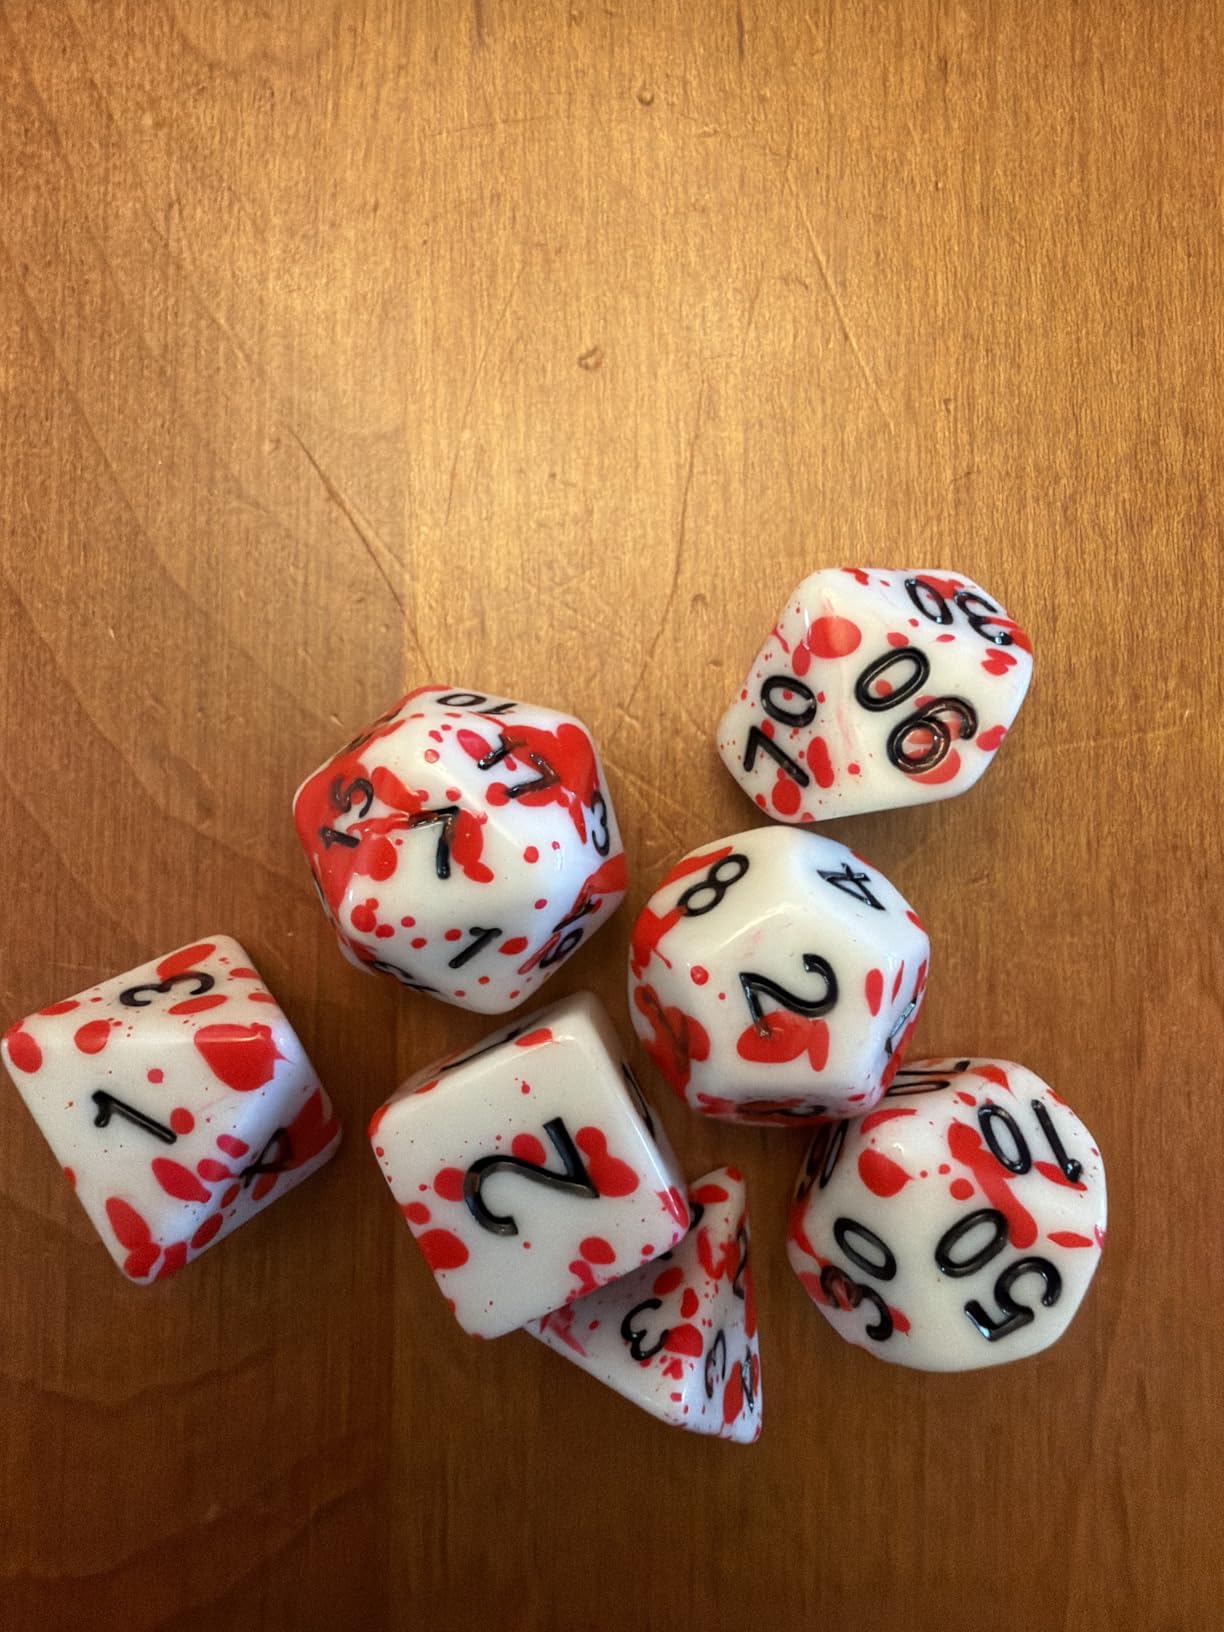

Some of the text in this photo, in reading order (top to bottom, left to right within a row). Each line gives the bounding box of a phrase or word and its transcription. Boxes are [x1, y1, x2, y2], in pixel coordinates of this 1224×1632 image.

[676, 853, 750, 917] 8
[816, 862, 886, 911] 4
[119, 971, 215, 1007] 3
[739, 953, 839, 1038] 2
[91, 1089, 178, 1145] 1
[463, 1116, 600, 1237] 2
[620, 1298, 670, 1362] 3
